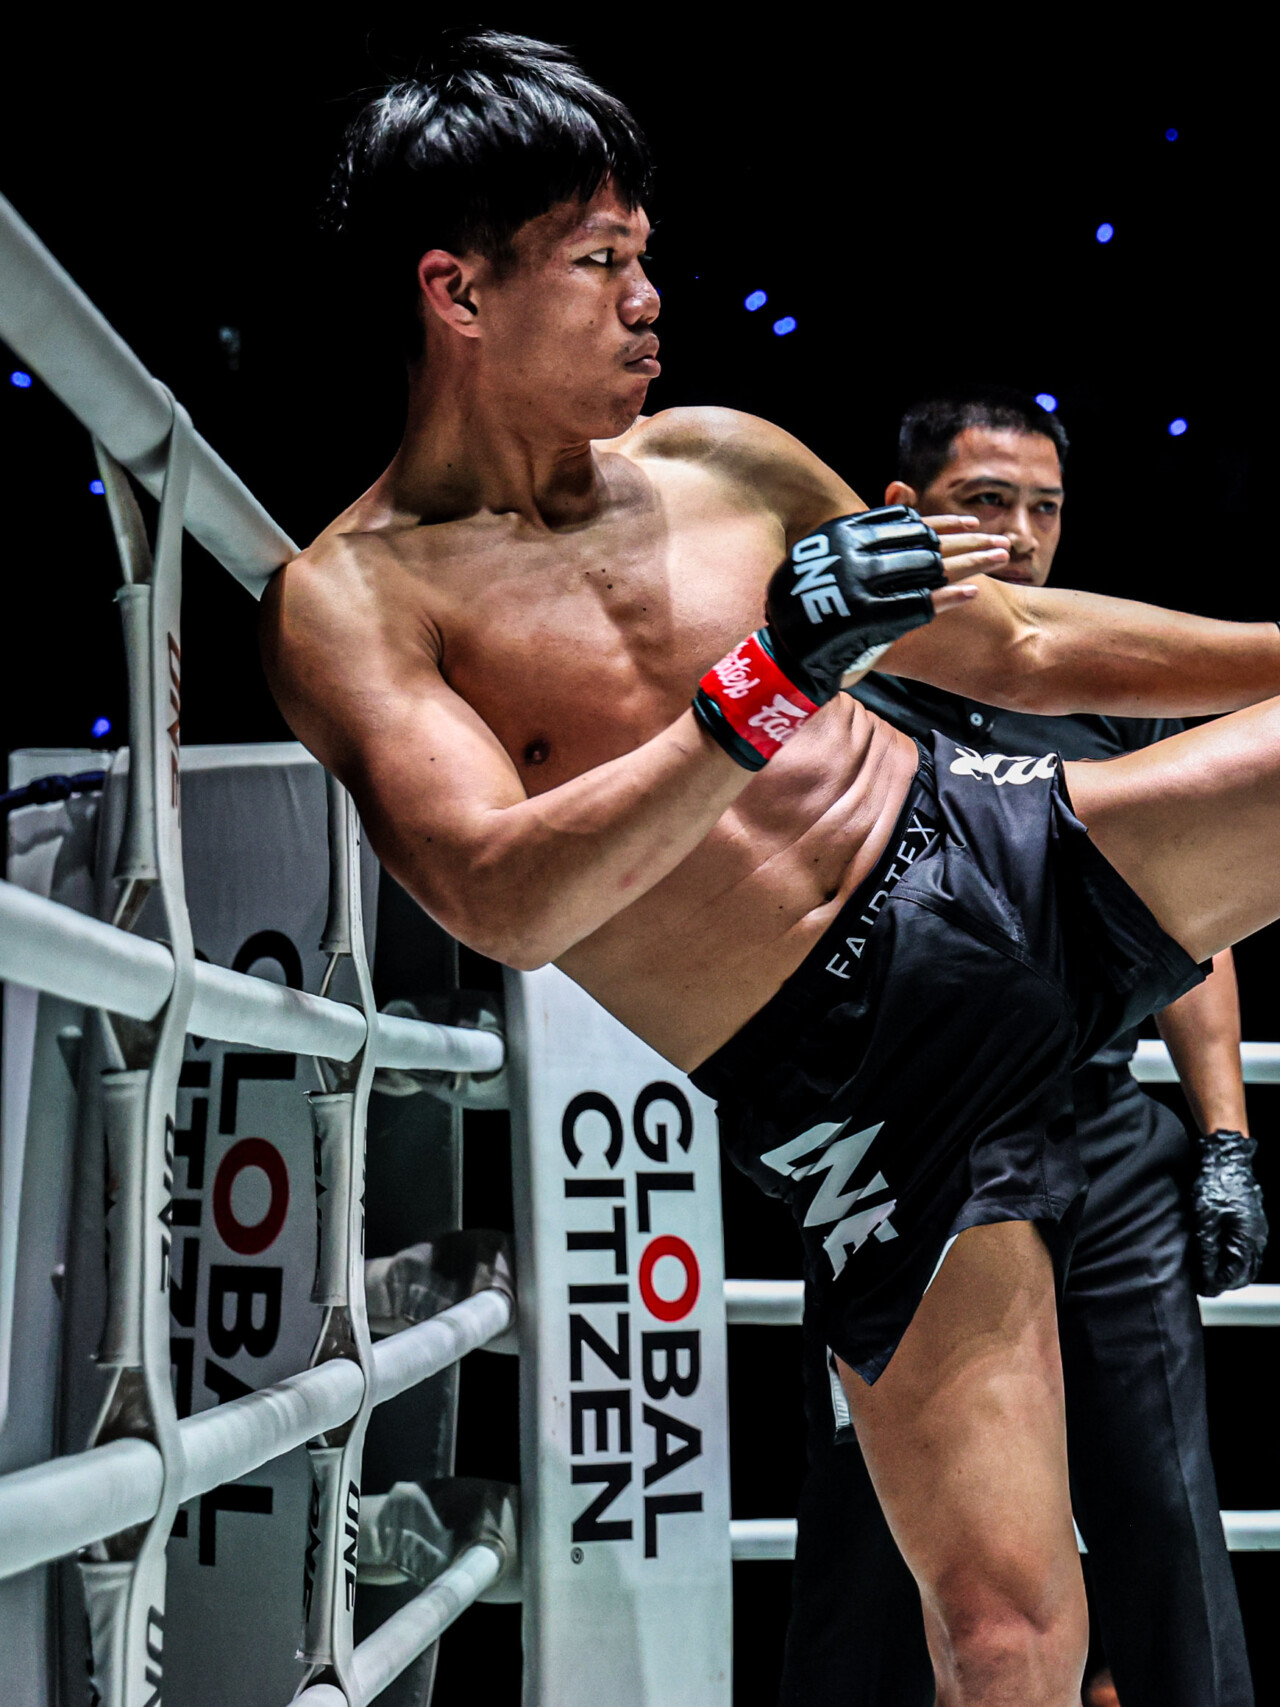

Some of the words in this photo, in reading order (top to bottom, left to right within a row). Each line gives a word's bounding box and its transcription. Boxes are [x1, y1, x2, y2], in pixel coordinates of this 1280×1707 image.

[790, 534, 851, 625] ONE
[561, 1090, 634, 1544] CITIZEN
[632, 1080, 704, 1560] GLOBAL
